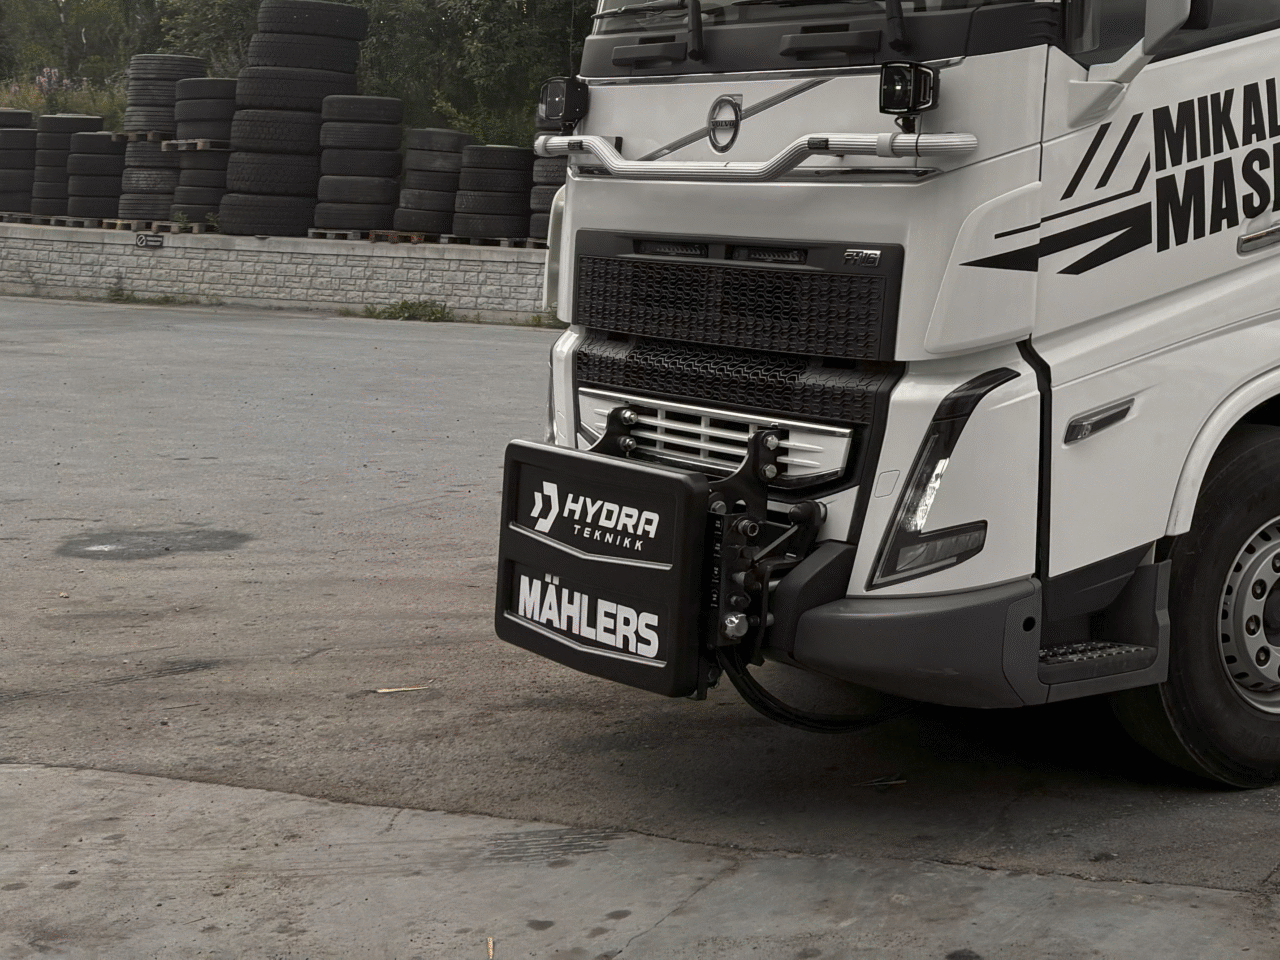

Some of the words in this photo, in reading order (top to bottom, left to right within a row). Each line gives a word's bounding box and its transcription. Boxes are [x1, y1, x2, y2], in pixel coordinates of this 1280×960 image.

[711, 120, 735, 128] VOLVO
[563, 493, 660, 539] HYDRA
[573, 524, 644, 551] TEKNIKK
[518, 573, 659, 658] MÄHLERS
